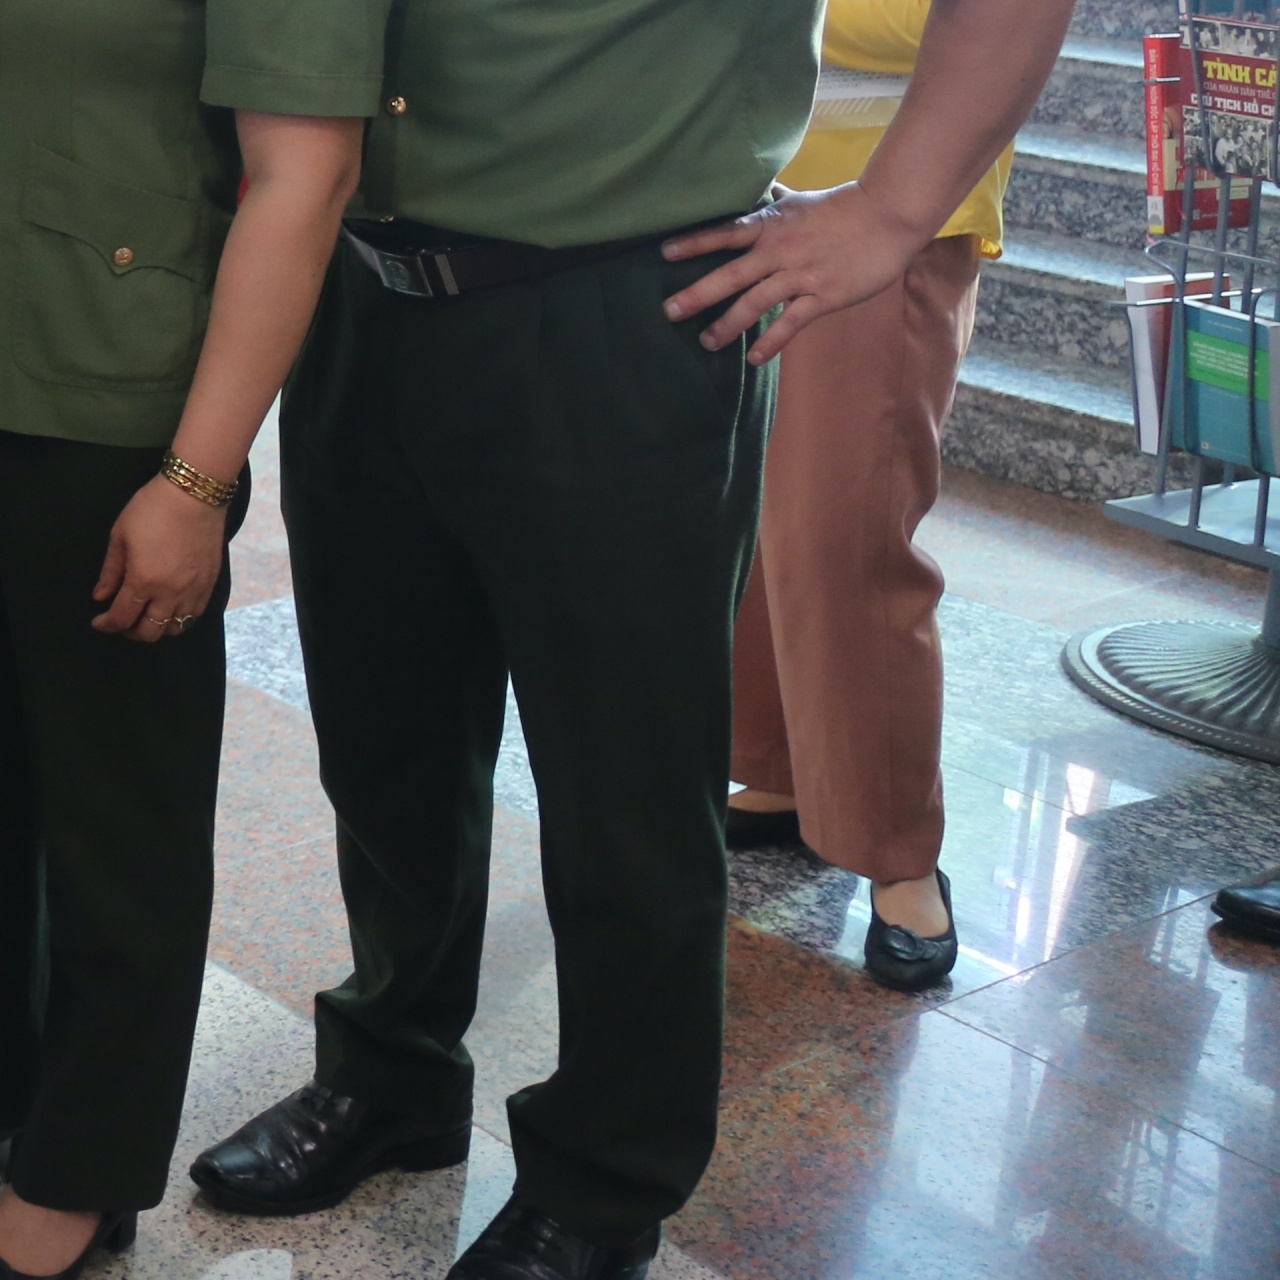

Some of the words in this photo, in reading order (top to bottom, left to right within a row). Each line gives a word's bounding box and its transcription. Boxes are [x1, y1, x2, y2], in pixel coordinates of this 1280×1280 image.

[1203, 57, 1251, 84] TÌNH
[1219, 81, 1239, 95] NHÂN
[1214, 97, 1241, 111] TỊCH
[1243, 98, 1259, 114] HỒ
